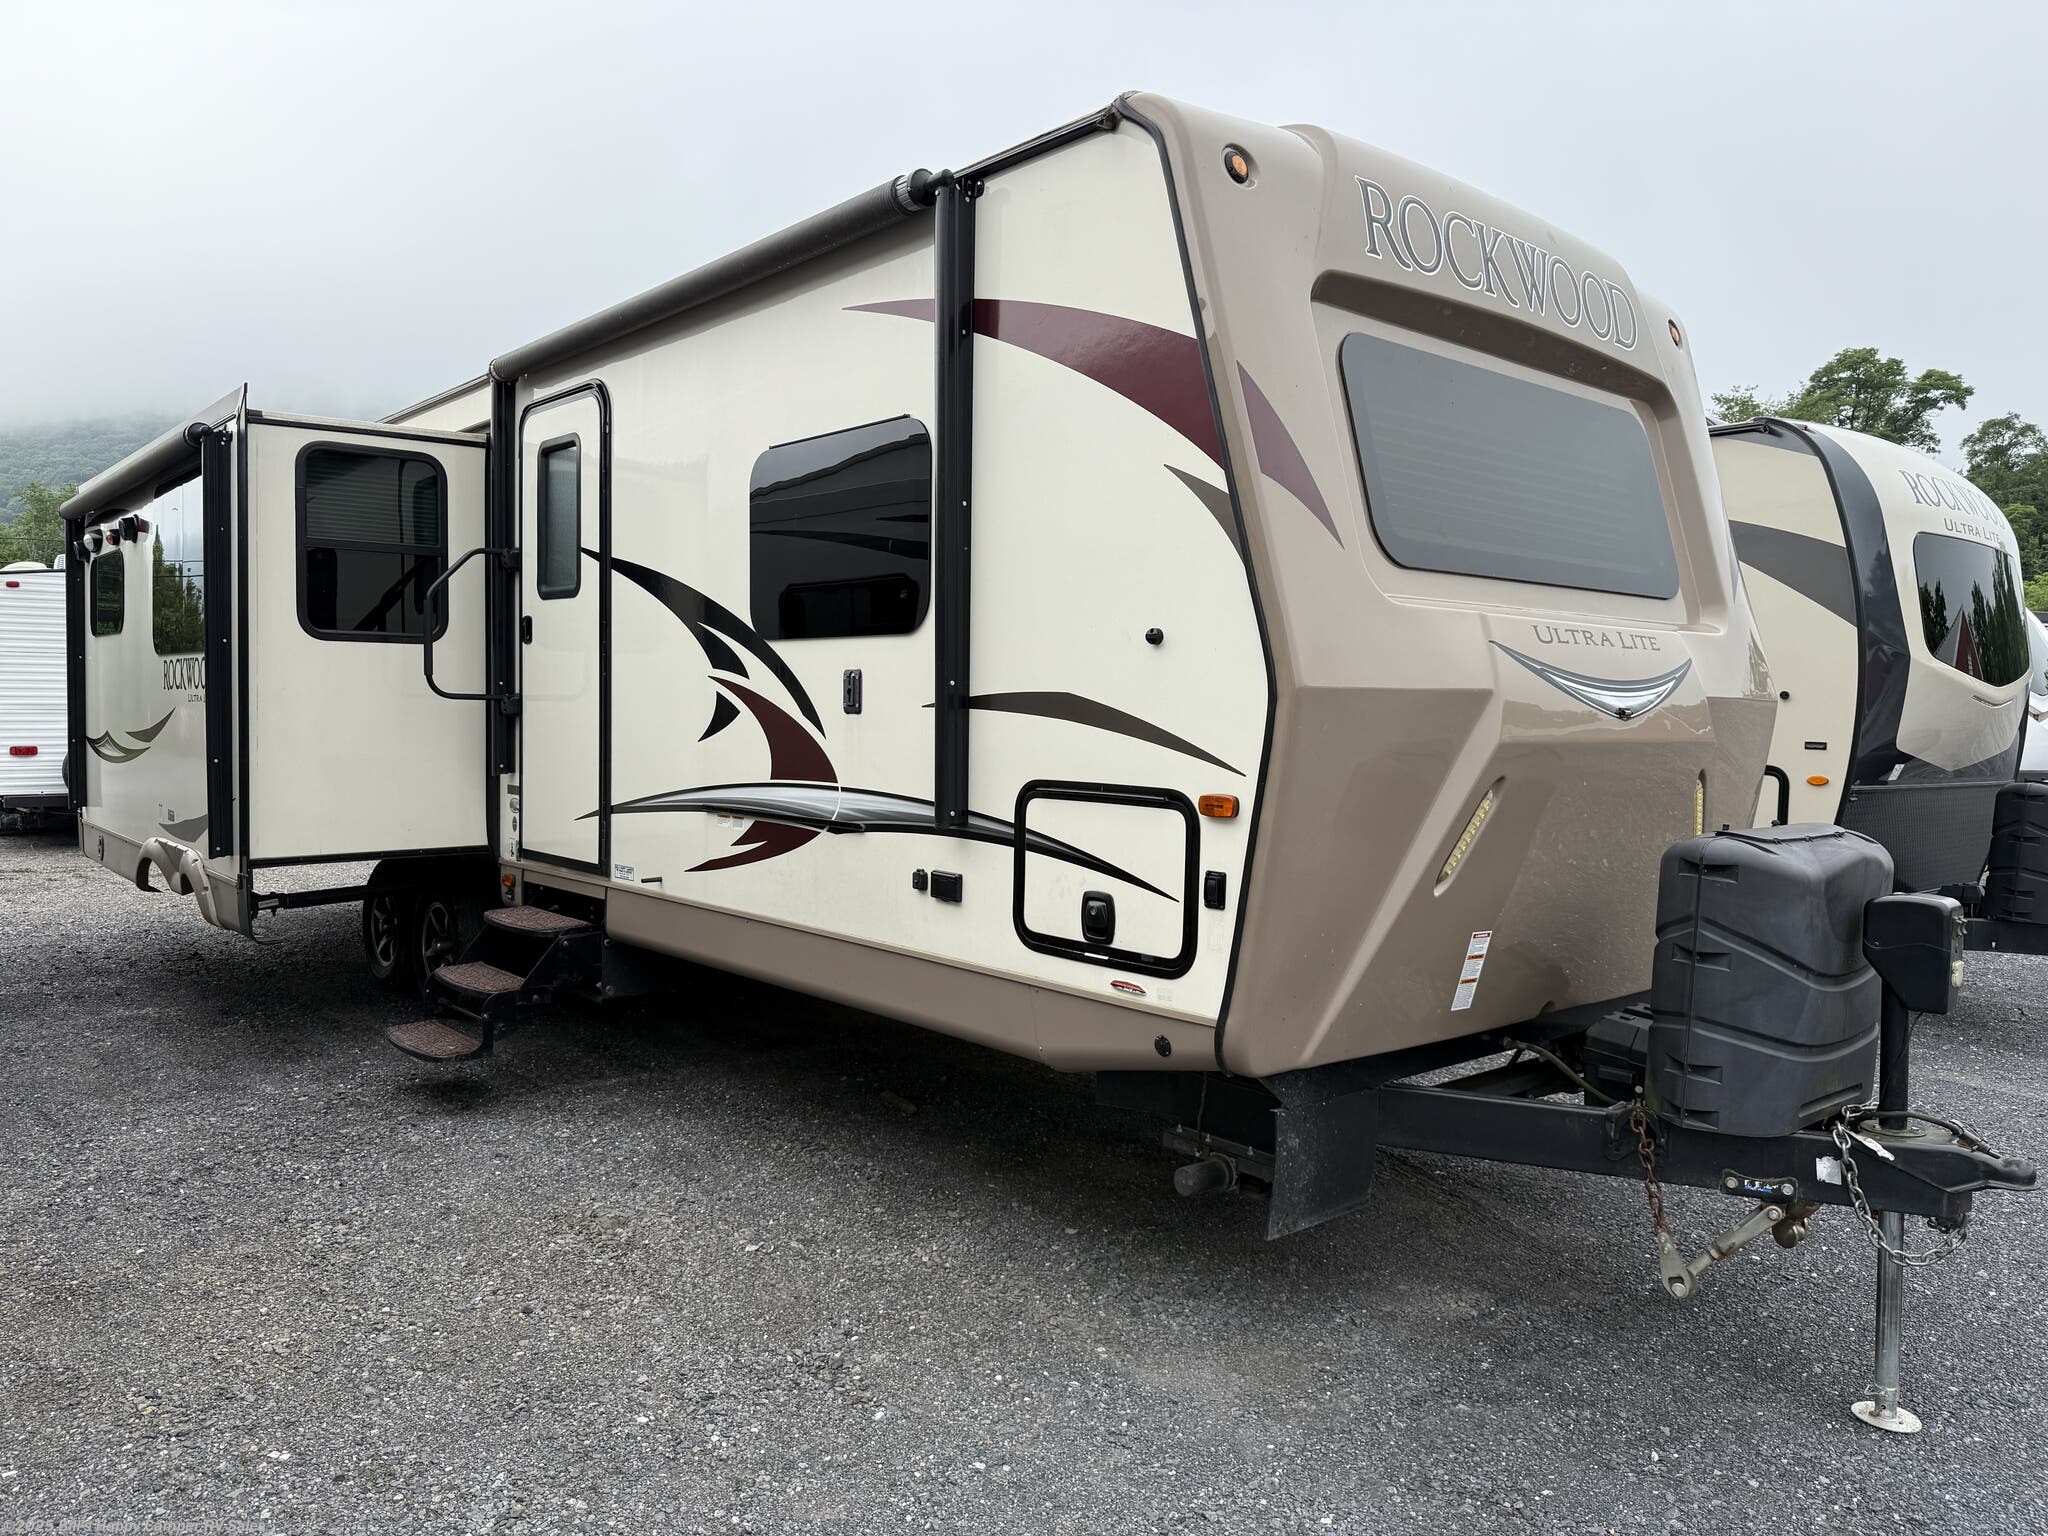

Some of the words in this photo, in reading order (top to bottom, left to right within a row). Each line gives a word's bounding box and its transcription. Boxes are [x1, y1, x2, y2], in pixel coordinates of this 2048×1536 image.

[1355, 175, 1638, 350] ROCKWOOD
[1943, 517, 1981, 538] ULTRA
[1983, 526, 2001, 543] LITE
[1532, 624, 1616, 647] ULTRA
[1617, 631, 1661, 651] LITE
